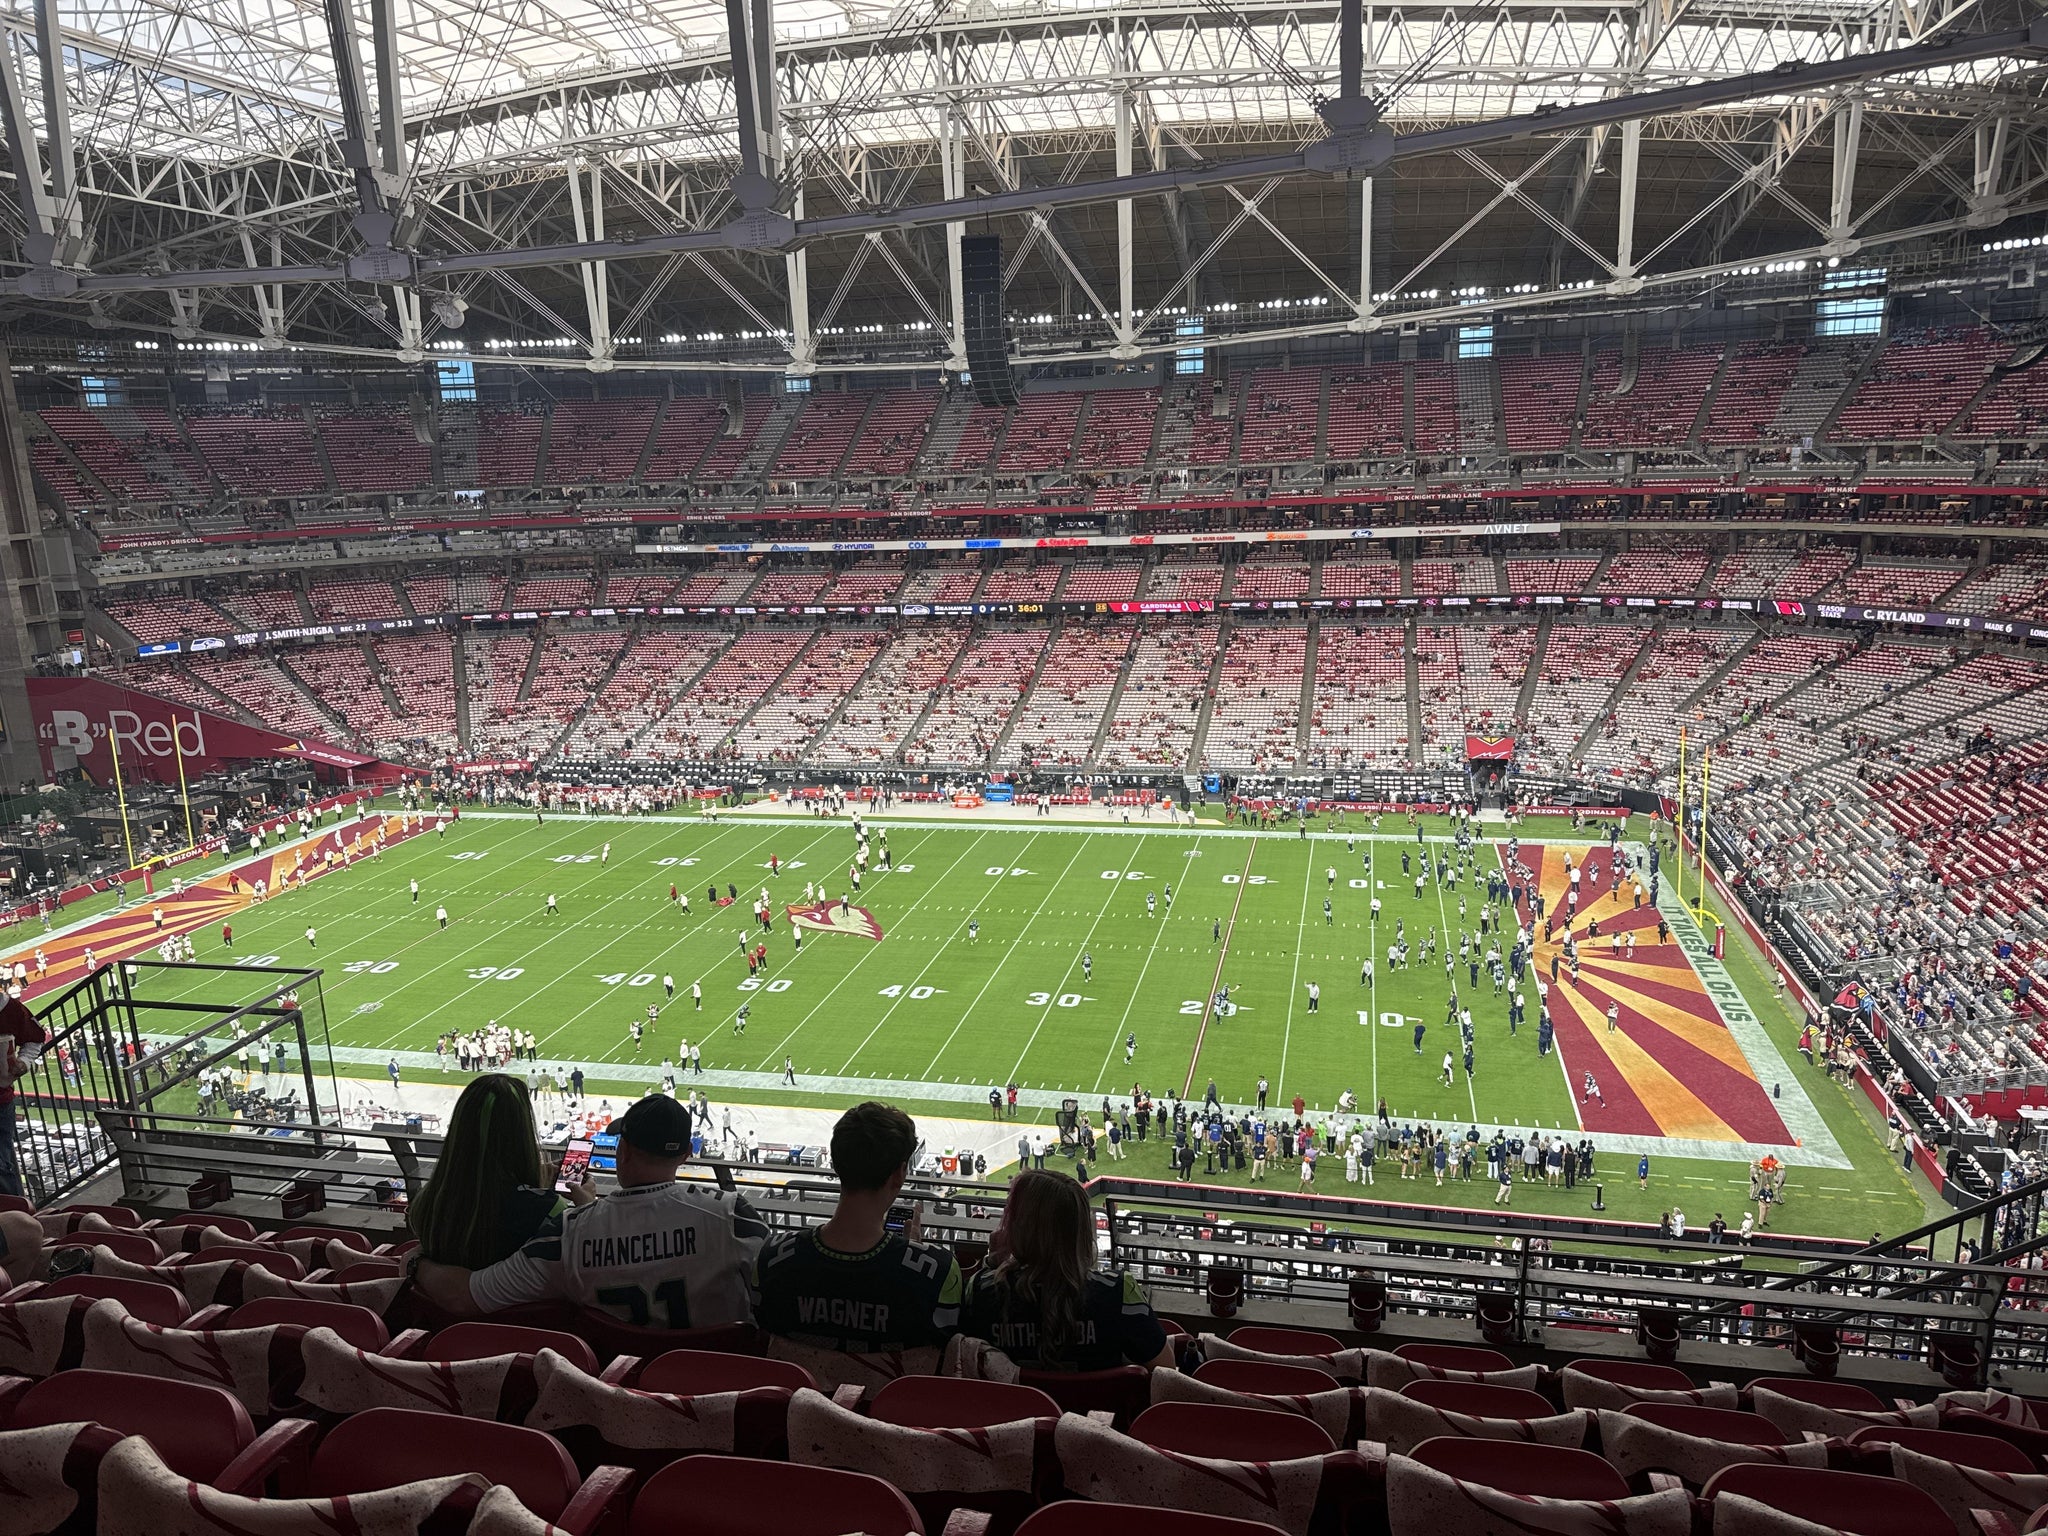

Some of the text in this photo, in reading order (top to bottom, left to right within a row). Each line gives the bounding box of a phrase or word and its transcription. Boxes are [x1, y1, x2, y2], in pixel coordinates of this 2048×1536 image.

[1411, 493, 1436, 501] (NIGHT
[1437, 492, 1462, 500] TRAIN)
[1484, 523, 1530, 534] AVNET
[139, 540, 170, 548] (PADDY)
[171, 537, 204, 545] DRISCOLL
[908, 541, 928, 549] COX
[979, 605, 986, 613] 0
[1018, 604, 1043, 613] 36:01
[1122, 603, 1129, 611] 0
[1817, 605, 1846, 613] SEASON
[1820, 611, 1842, 619] STATS
[1863, 609, 1926, 623] C. RYLAND
[397, 619, 413, 628] 323
[1945, 617, 1971, 627] ATT 8
[1984, 622, 2013, 633] MADE 6
[234, 633, 258, 641] SEASON
[272, 626, 334, 639] SMITH-NJIGBA
[238, 638, 256, 646] STATS
[310, 749, 362, 766] verizon
[985, 867, 1029, 876] 40
[1100, 870, 1145, 880] 30
[1222, 874, 1268, 885] 20
[1349, 878, 1386, 889] 10
[342, 960, 400, 974] 20
[1661, 905, 1753, 1022] IT TAKES ALL OF US
[468, 966, 526, 981] 30
[600, 972, 657, 986] 40
[736, 977, 794, 992] 50
[877, 984, 935, 1000] 40
[1025, 992, 1083, 1008] 30
[1356, 1010, 1405, 1028] 10
[582, 1226, 696, 1268] CHANCELLOR
[797, 1294, 890, 1334] WAGNER
